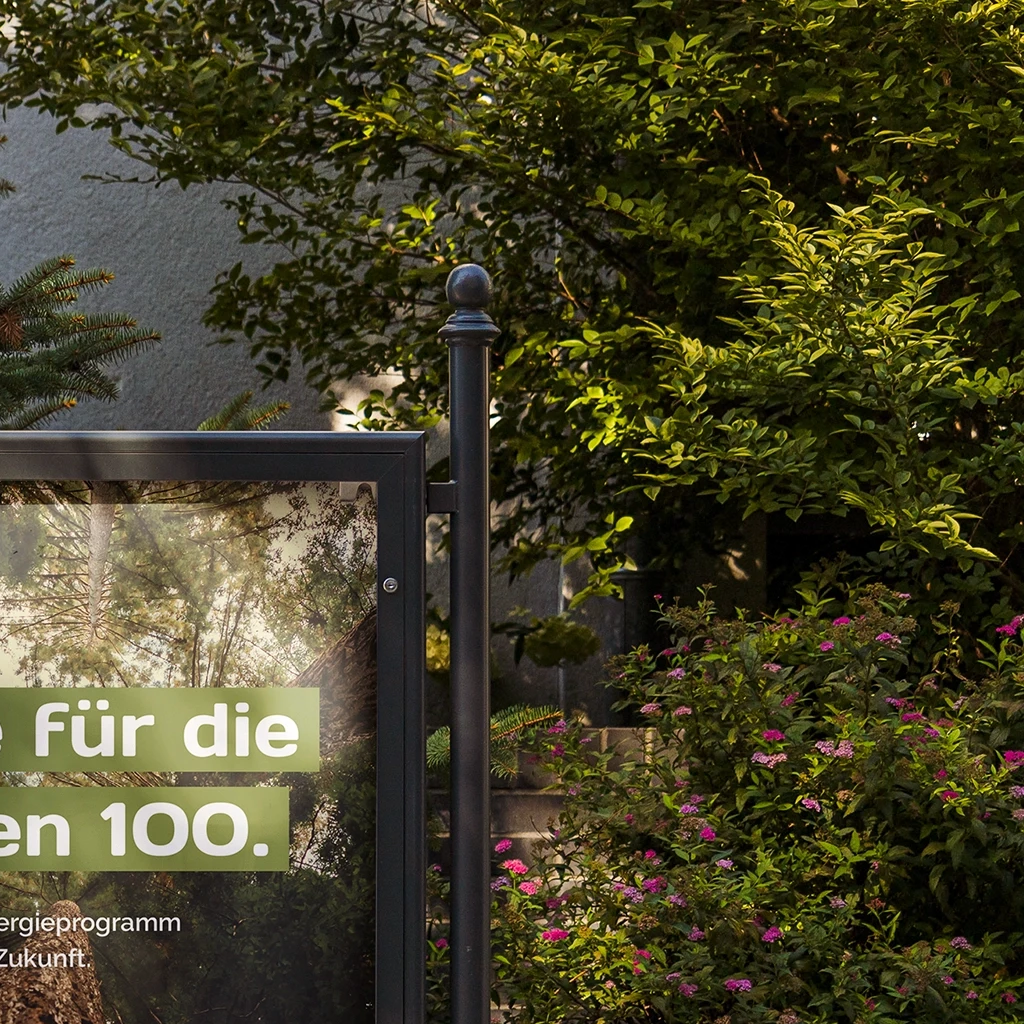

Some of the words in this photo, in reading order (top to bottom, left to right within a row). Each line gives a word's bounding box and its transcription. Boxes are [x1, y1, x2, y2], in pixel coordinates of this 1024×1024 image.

[35, 701, 155, 758] für
[183, 703, 300, 758] die
[100, 802, 269, 858] 100.
